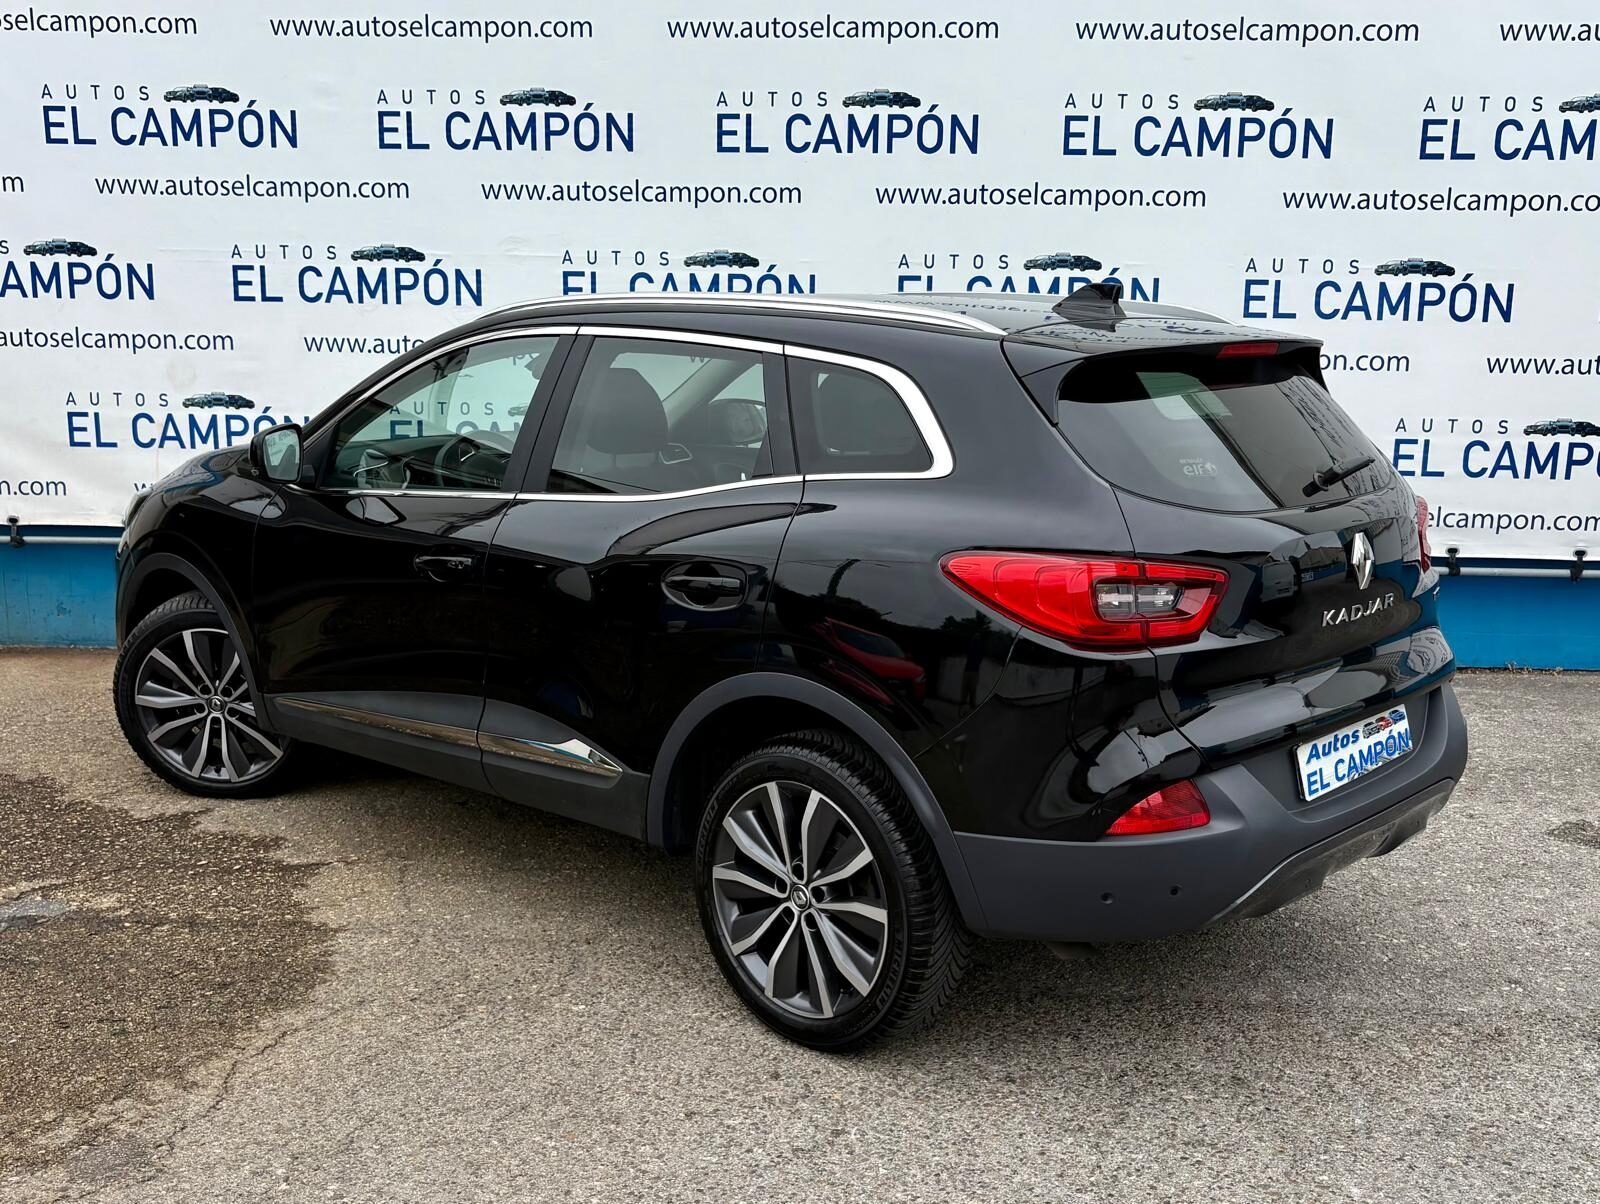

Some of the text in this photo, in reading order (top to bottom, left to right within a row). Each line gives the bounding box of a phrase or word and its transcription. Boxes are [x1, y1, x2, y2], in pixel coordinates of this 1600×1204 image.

[0, 7, 197, 39] selcampon.com
[269, 13, 593, 44] www.autoselcampon.com
[667, 13, 999, 45] www.autoselcampon.com
[1075, 16, 1419, 48] www.autoselcampon.com
[41, 83, 150, 102] AUTOS
[376, 89, 485, 105] AUTOS
[716, 91, 828, 108] AUTOS
[1064, 92, 1179, 110] AUTOS
[1423, 95, 1543, 113] AUTOS
[42, 100, 298, 149] EL CAMPÓN
[377, 103, 634, 153] EL CAMPÓN
[716, 105, 979, 155] EL CAMPÓN
[1062, 108, 1334, 159] EL CAMPÓN
[1418, 118, 1598, 161] EL CAM
[94, 173, 410, 204] www.autoselcampon.com
[480, 178, 802, 209] www.autoselcampon.com
[875, 181, 1206, 212] www.autoselcampon.com
[1282, 186, 1600, 218] www.autoselcampon.co
[231, 244, 337, 261] AUTOS
[561, 249, 670, 267] AUTOS
[898, 253, 1009, 270] AUTOS
[1245, 257, 1360, 275] AUTOS
[0, 253, 155, 301] AMPÓN
[231, 258, 482, 307] EL CAMPÓN
[1242, 273, 1515, 323] EL CAMPÓN
[0, 326, 234, 355] autoselcampon.com
[65, 391, 169, 408] AUTOS
[66, 406, 309, 449] EL CAMPÓ
[1395, 417, 1509, 435] AUTOS
[1393, 438, 1600, 481] EL CAMP
[1321, 592, 1394, 628] KADJAR
[1306, 729, 1360, 765] Autos
[1306, 728, 1410, 796] EL CAMPÓN
